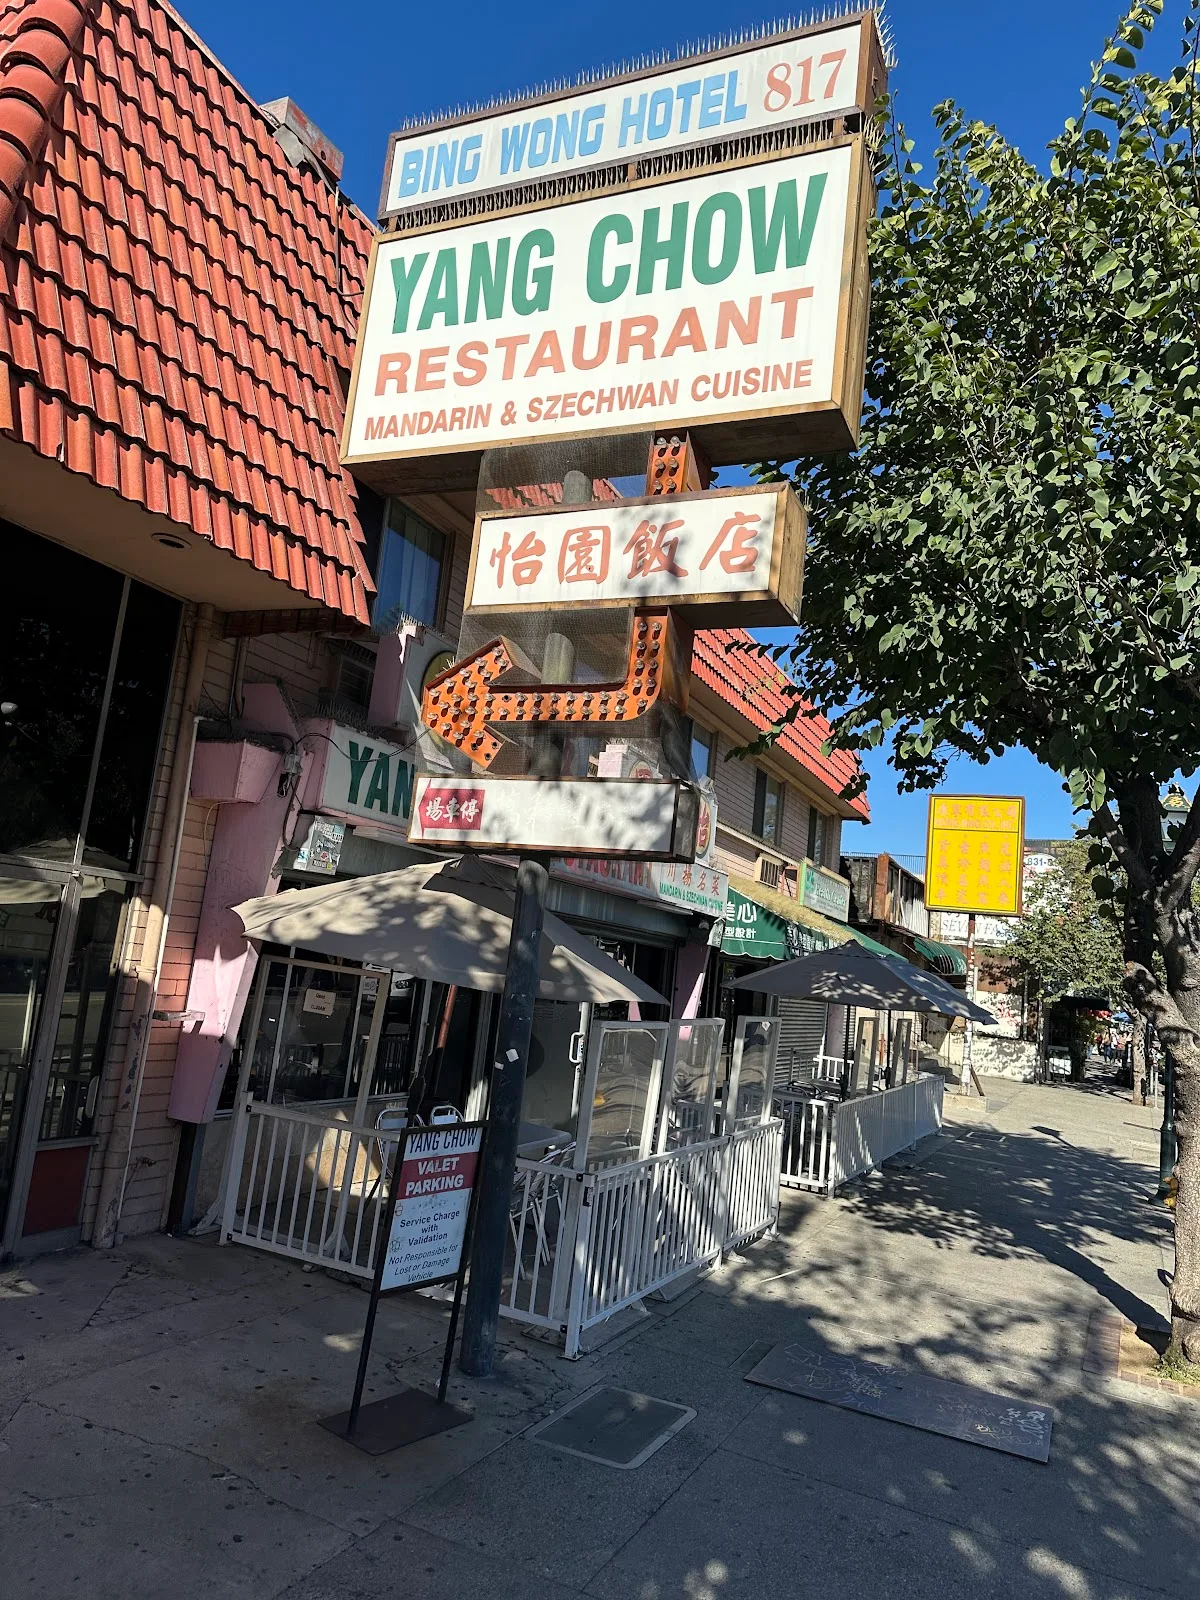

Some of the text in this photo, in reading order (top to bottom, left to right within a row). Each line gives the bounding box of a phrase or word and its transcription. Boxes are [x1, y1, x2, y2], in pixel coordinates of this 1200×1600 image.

[398, 48, 847, 198] BING WONG HOTEL 817
[391, 172, 828, 335] YANG CHOW
[374, 287, 814, 396] RESTAURANT
[364, 359, 813, 441] MANDARIN & SZECHWAN CUISINE
[489, 511, 763, 588] 怡園飯店
[409, 1128, 478, 1153] YANG CHOW
[418, 1157, 460, 1175] VALET
[405, 1174, 464, 1196] PARKING
[400, 1210, 460, 1228] Service Charge
[421, 1223, 438, 1234] with
[408, 1232, 448, 1247] Validation
[388, 1244, 459, 1266] Not Responsible for
[394, 1257, 450, 1276] Lost or Damage
[407, 1270, 434, 1283] Vehicle
